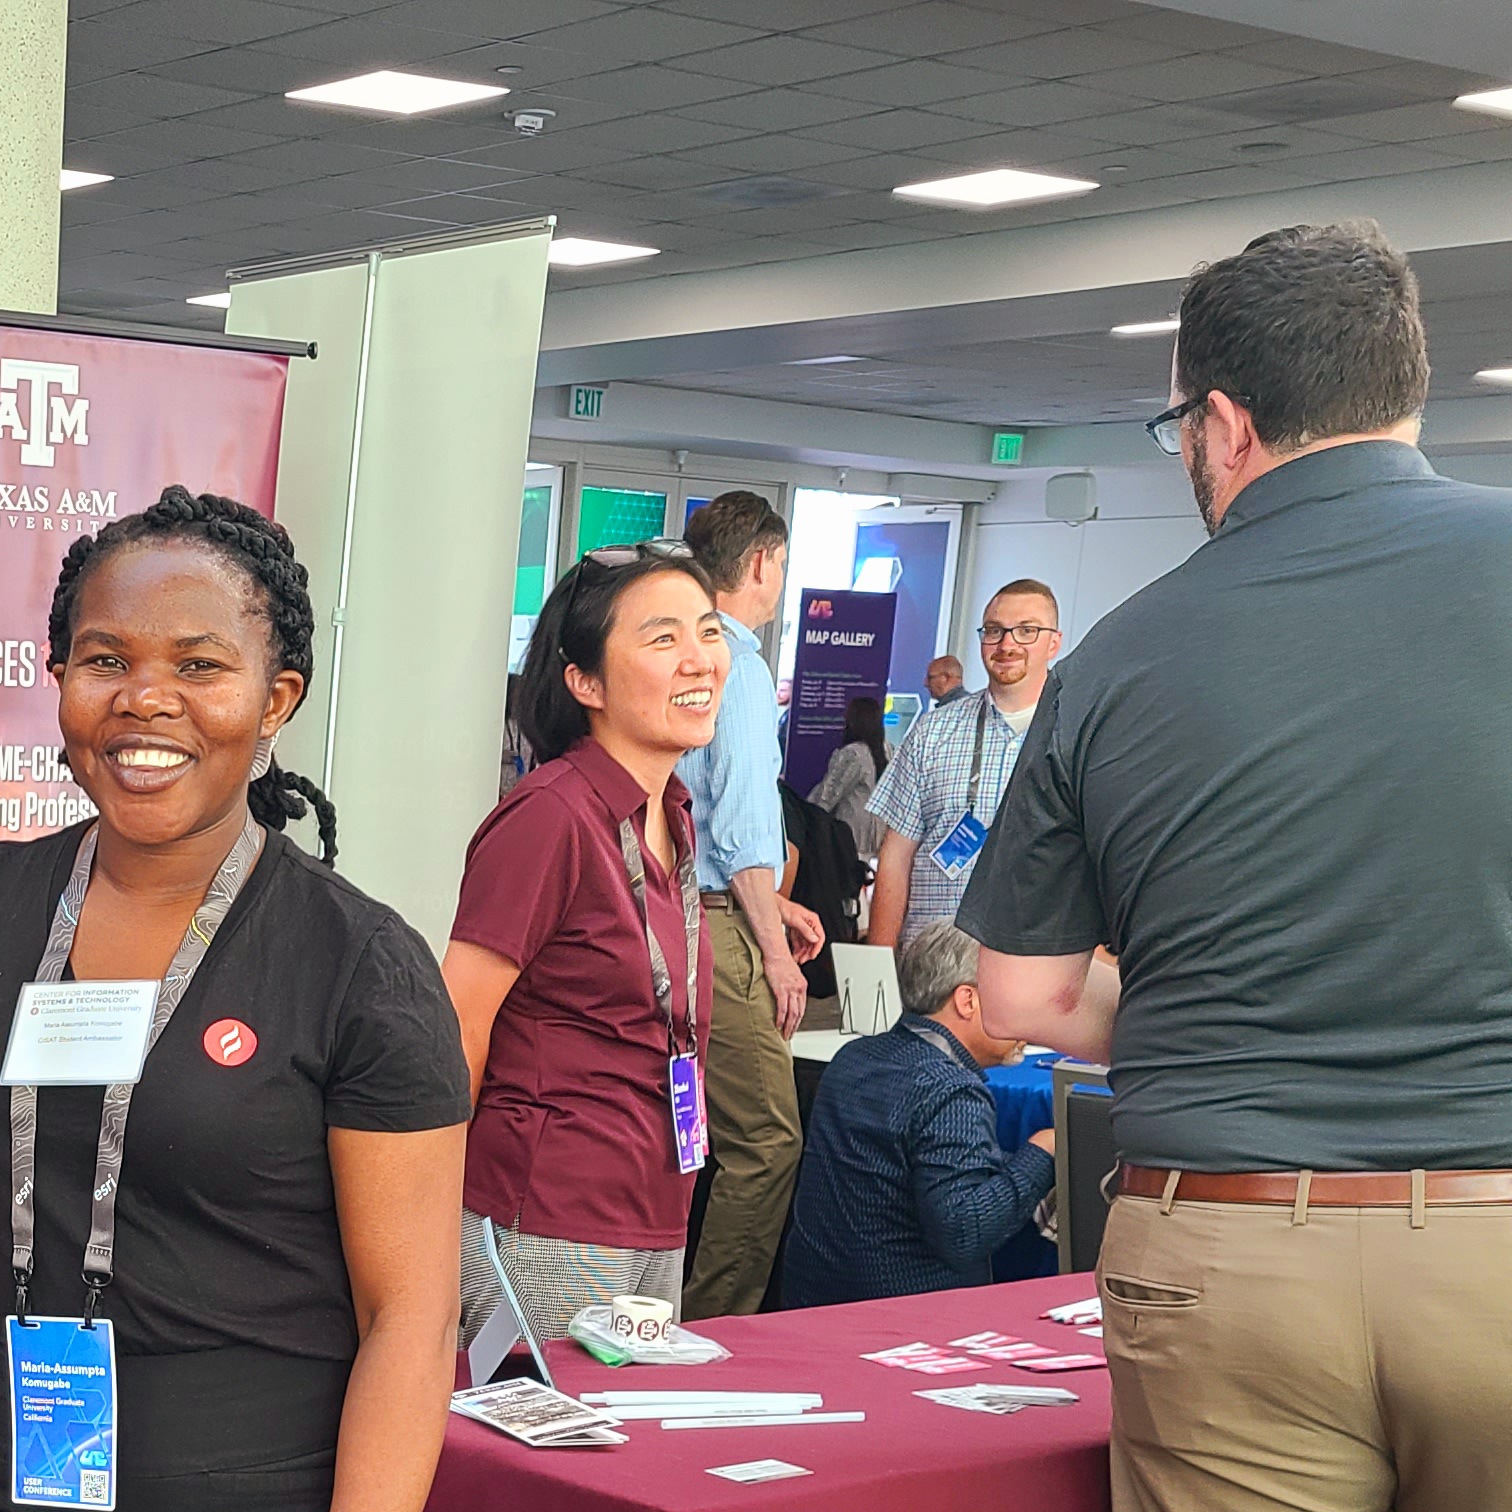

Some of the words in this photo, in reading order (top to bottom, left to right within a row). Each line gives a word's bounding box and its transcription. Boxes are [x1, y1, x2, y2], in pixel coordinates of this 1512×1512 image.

[575, 388, 603, 418] EXIT
[56, 488, 118, 517] A&M
[806, 629, 830, 645] MAP
[830, 631, 875, 647] GALLERY
[33, 991, 63, 999] CENTER
[65, 990, 82, 998] FOR
[83, 988, 139, 997] INFORMATION
[32, 998, 66, 1006] SYSTEMS
[76, 996, 130, 1005] TECHNOLOGY
[40, 1006, 75, 1016] Claremont
[76, 1005, 106, 1014] Graduate
[108, 1004, 143, 1015] University
[15, 1176, 34, 1206] esri
[93, 1172, 118, 1202] esri
[20, 1360, 106, 1379] Maria-Assumpta
[22, 1396, 55, 1405] Claremont
[56, 1397, 85, 1407] Graduate
[22, 1404, 53, 1414] University
[22, 1413, 53, 1423] California
[23, 1476, 43, 1487] USER
[23, 1485, 73, 1498] CONFERENCE
